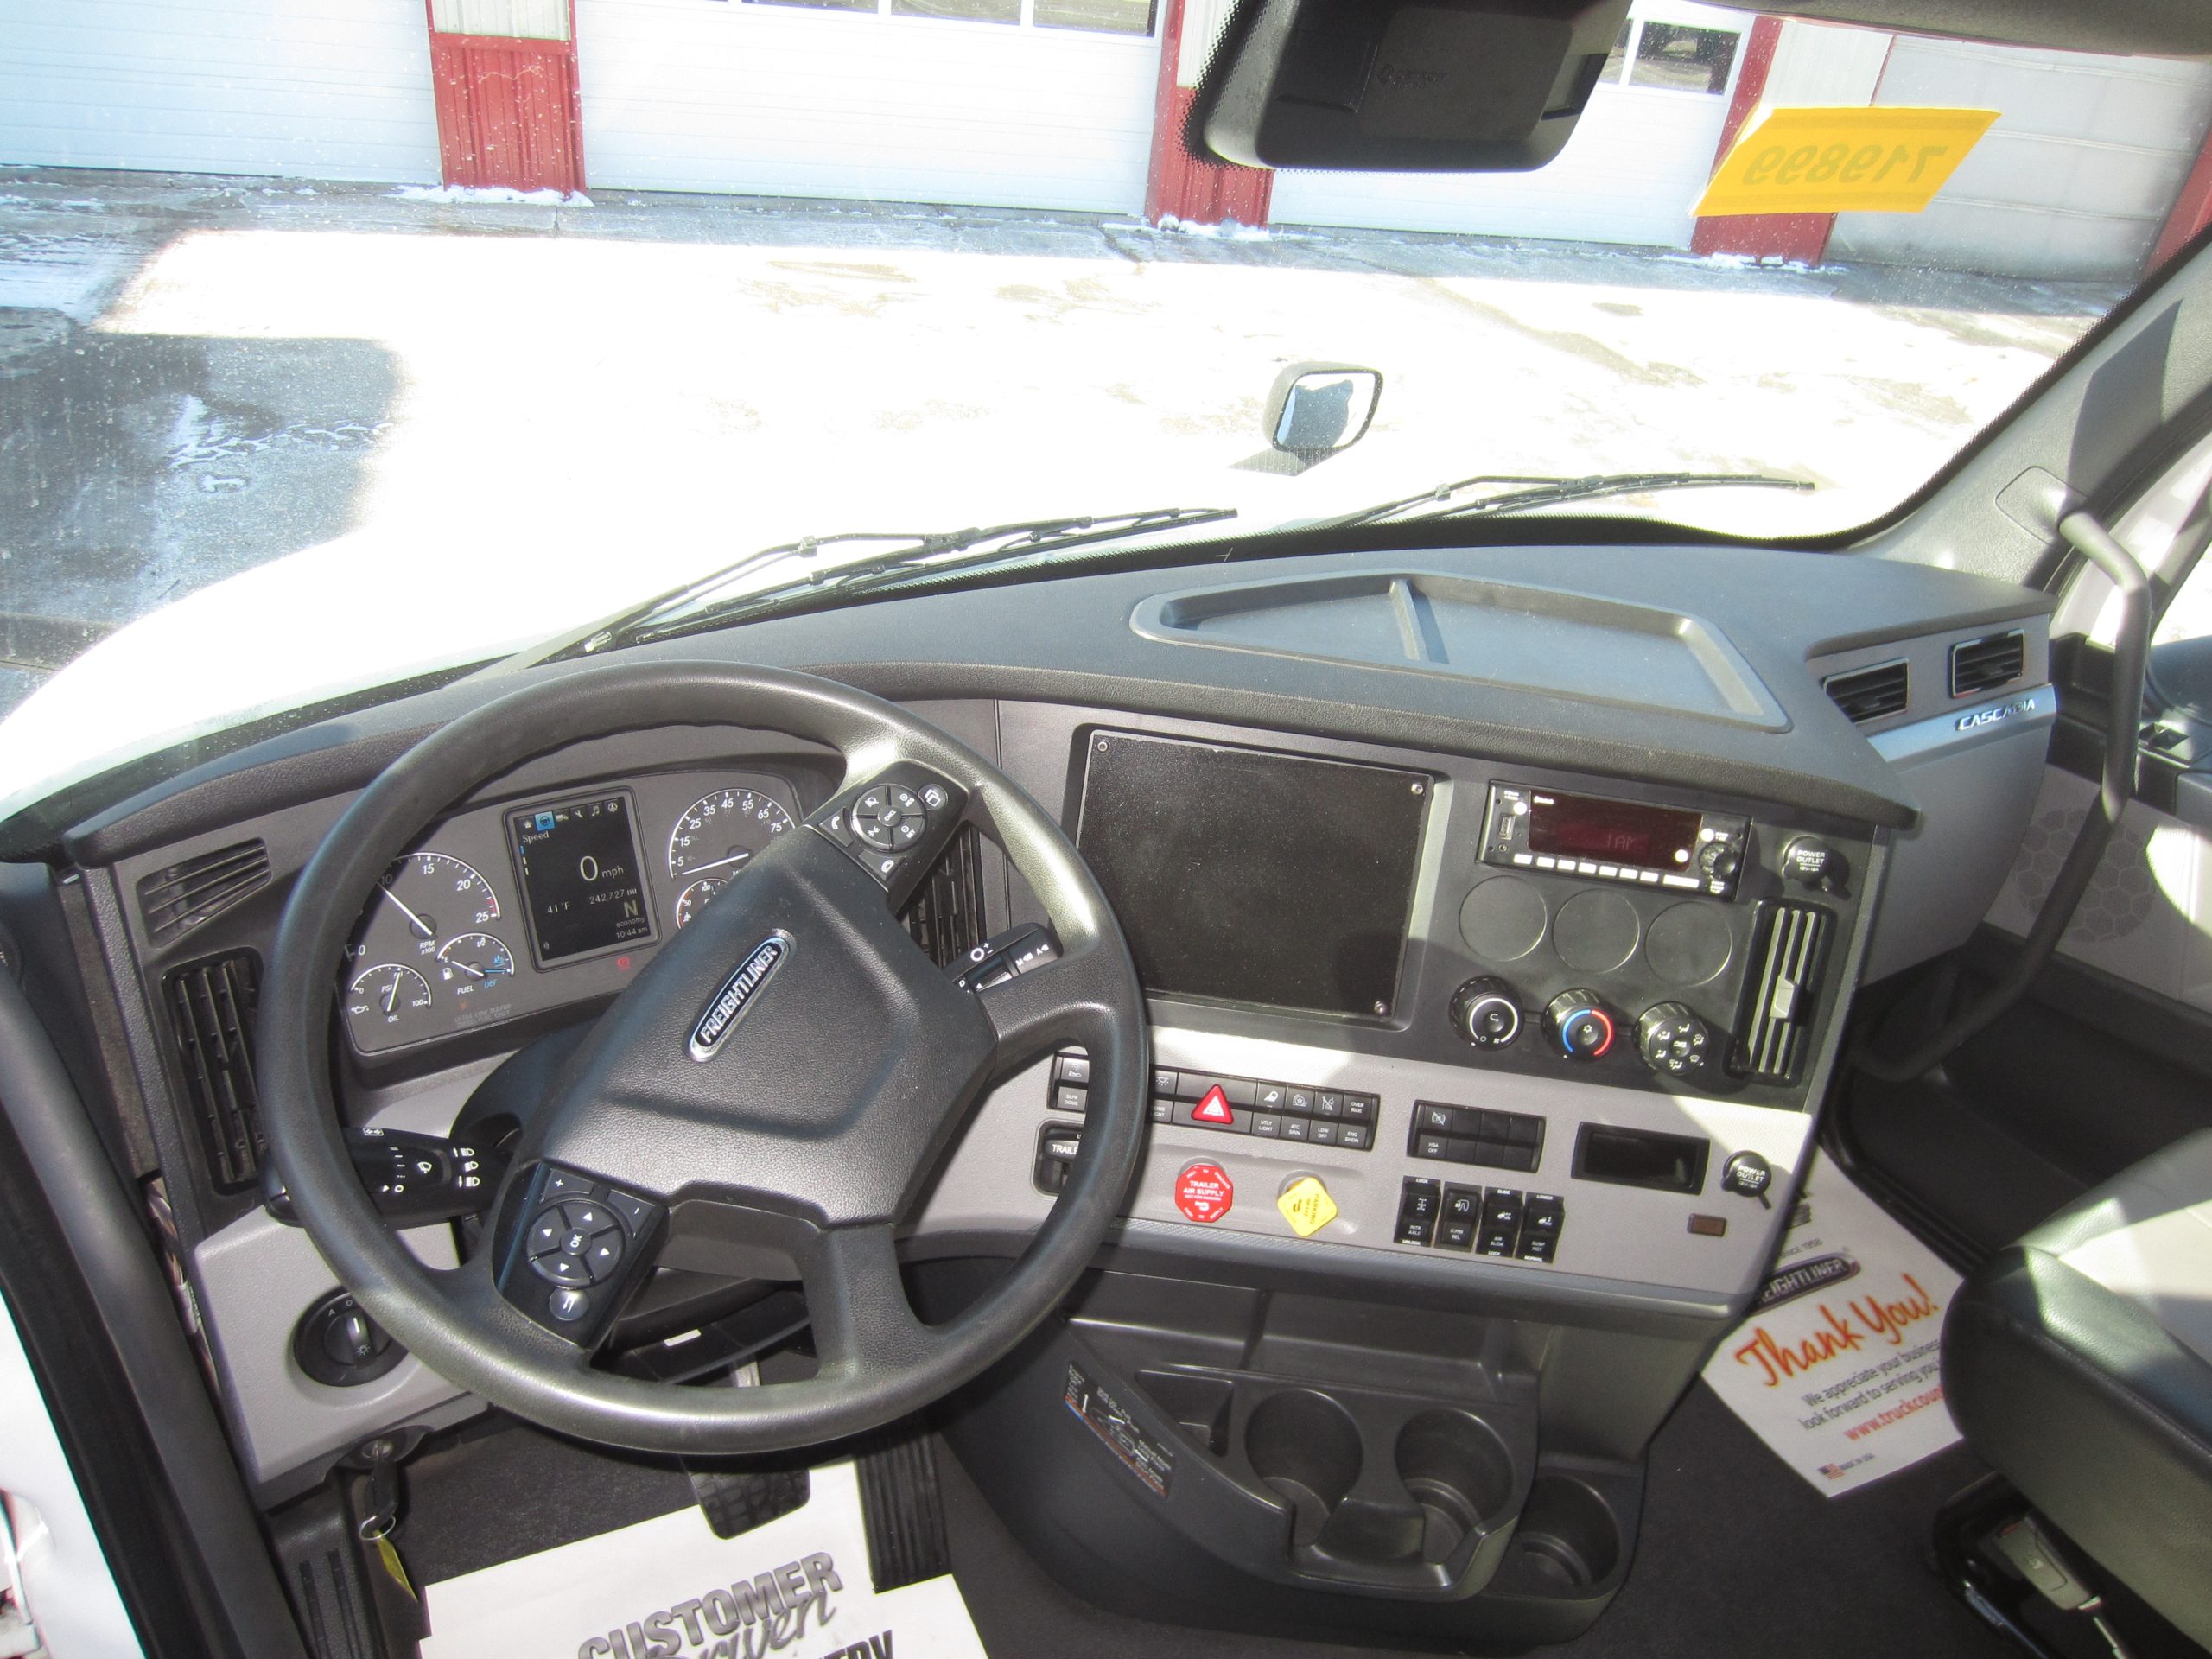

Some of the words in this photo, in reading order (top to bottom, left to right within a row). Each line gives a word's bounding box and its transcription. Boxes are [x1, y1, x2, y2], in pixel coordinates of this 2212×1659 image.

[1957, 698, 2035, 731] CASCADIA
[721, 798, 734, 809] 45
[741, 798, 753, 810] 55
[703, 805, 715, 816] 35
[757, 809, 769, 819] 65
[690, 817, 702, 830] 25
[771, 823, 783, 833] 75
[523, 831, 550, 843] Speed
[679, 836, 690, 847] 15
[677, 856, 684, 867] 5
[1796, 856, 1825, 865] OUTLET
[422, 864, 434, 874] 15
[580, 855, 598, 881] 0
[601, 866, 624, 879] mph
[456, 879, 471, 892] 20
[626, 887, 638, 897] mi
[547, 904, 558, 914] 41
[624, 899, 639, 918] N
[476, 912, 489, 924] 25
[616, 916, 645, 928] economy
[616, 928, 637, 939] 10:44
[420, 940, 435, 949] RPM
[358, 945, 366, 956] 0
[484, 980, 498, 988] DEF
[457, 985, 474, 995] FUEL
[700, 945, 778, 1044] FREIGHTLINER
[412, 999, 423, 1007] 100
[387, 1014, 399, 1023] OIL
[1738, 1165, 1766, 1177] POWER
[1737, 1172, 1764, 1183] OUTLET
[1190, 1180, 1219, 1189] TRAILER
[1197, 1188, 1224, 1197] SUPPLY
[569, 1234, 583, 1248] OK
[1763, 1258, 1848, 1303] EIGHTLINER
[1734, 1304, 1865, 1387] Thank
[1848, 1273, 1940, 1344] You!
[1801, 1391, 1825, 1407] We
[1823, 1368, 1879, 1400] appreciate
[1879, 1352, 1902, 1376] your
[1900, 1339, 1941, 1363] busines
[1798, 1411, 1829, 1430] look
[1824, 1392, 1870, 1420] forward
[1866, 1387, 1882, 1400] to
[1880, 1370, 1923, 1394] serving
[1844, 1384, 1943, 1441] www.truckcoun
